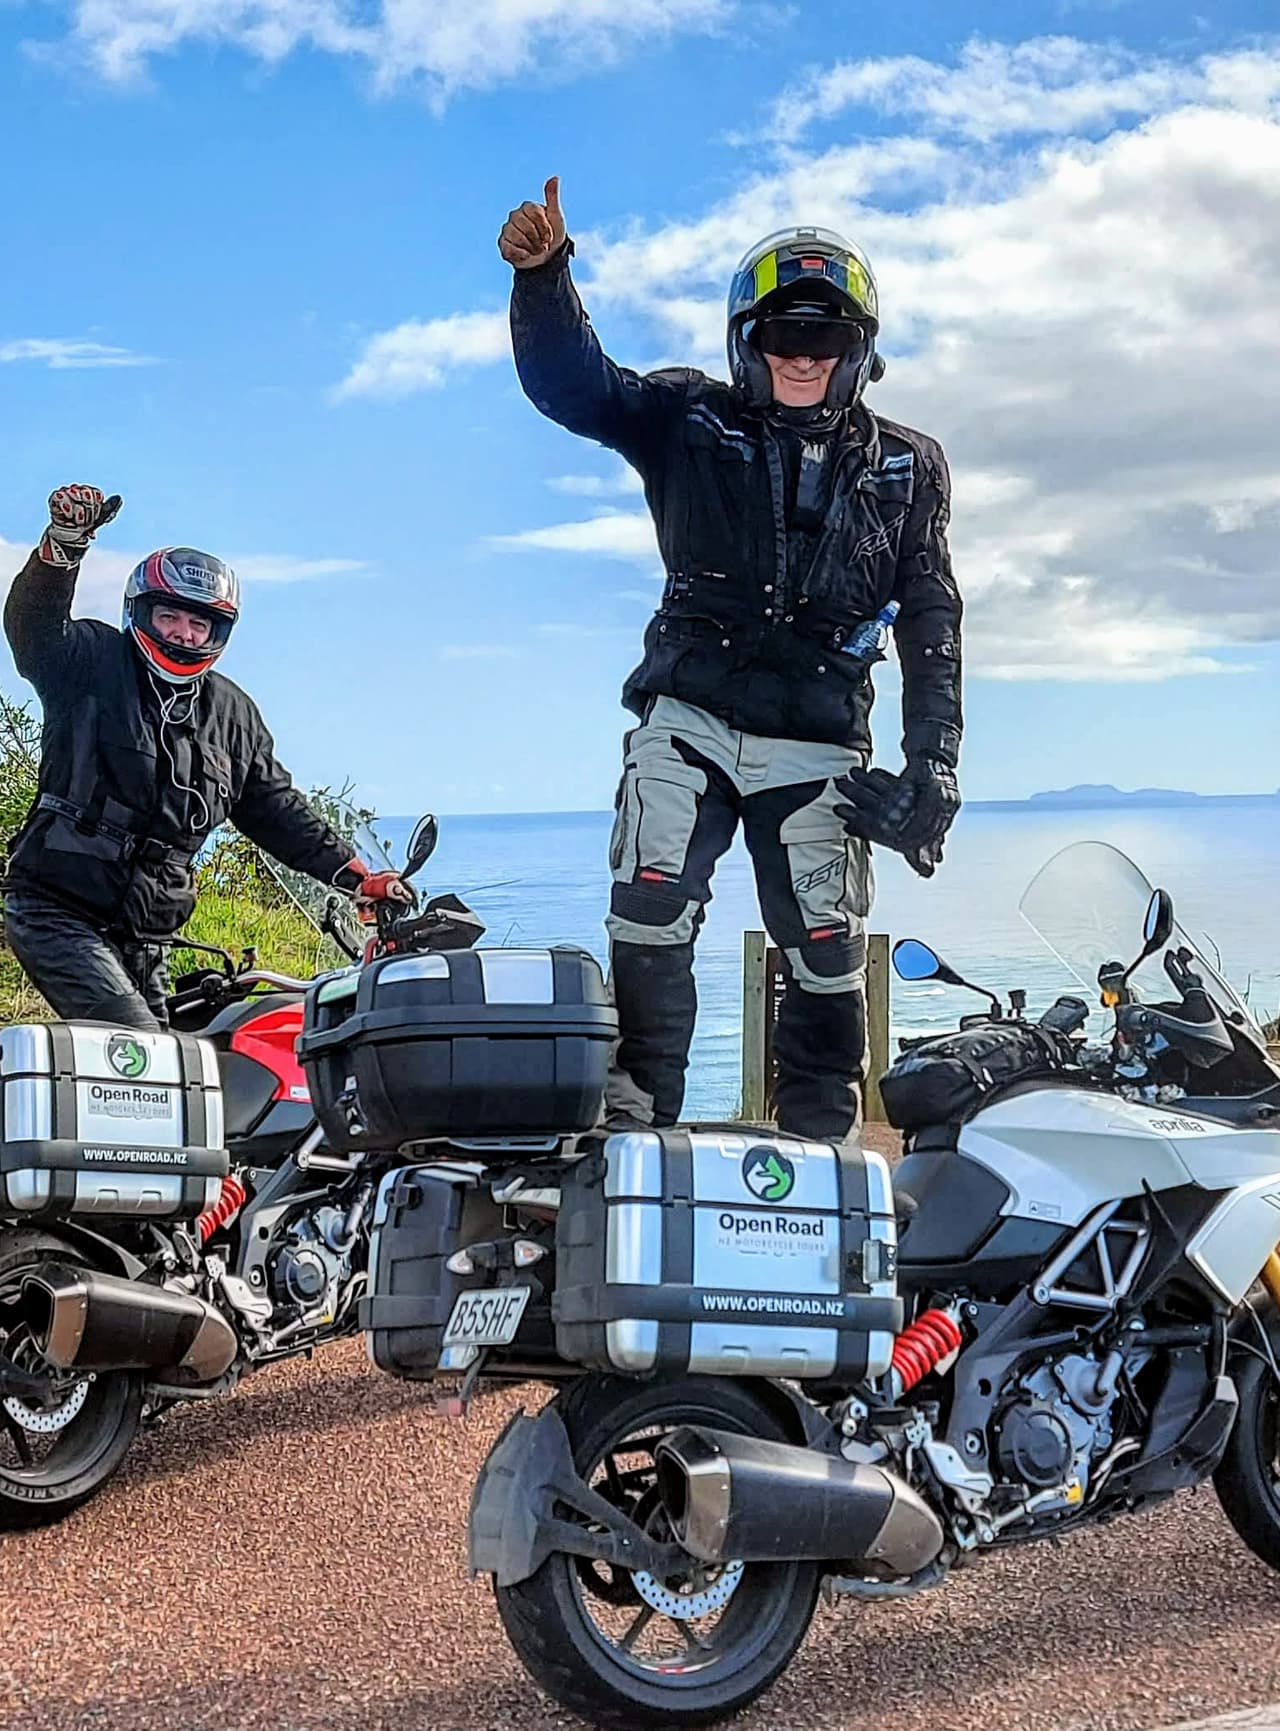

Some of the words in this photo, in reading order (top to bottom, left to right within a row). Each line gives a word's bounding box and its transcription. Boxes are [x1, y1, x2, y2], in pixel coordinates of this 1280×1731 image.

[185, 566, 215, 582] SHOEI
[793, 852, 847, 894] RST
[91, 1085, 131, 1103] Open
[132, 1088, 169, 1104] Road
[1148, 1116, 1206, 1133] aprilia
[83, 1148, 188, 1164] WWW.OPENROAD.NZ
[719, 1212, 772, 1236] Open
[774, 1216, 825, 1237] Road
[702, 1294, 845, 1316] WWW.OPENROAD.NZ
[448, 1296, 521, 1338] B5SHF
